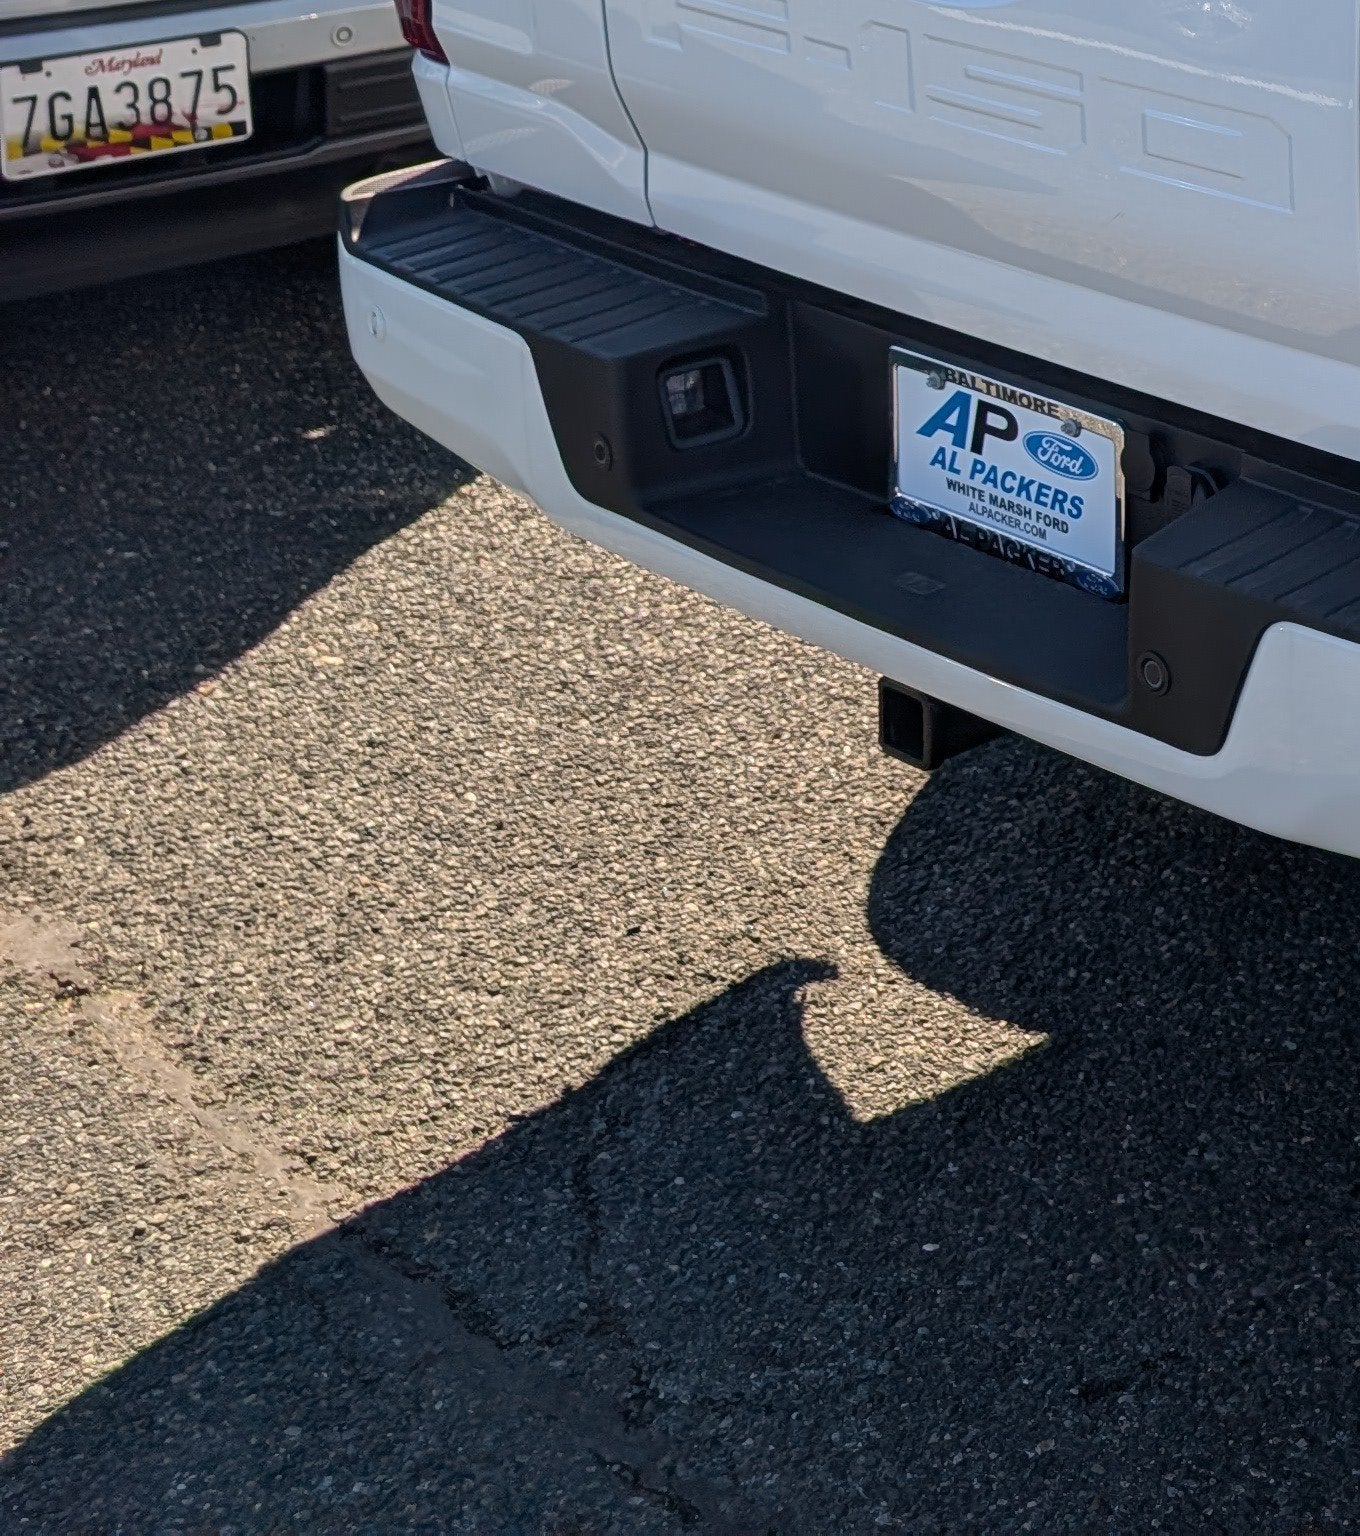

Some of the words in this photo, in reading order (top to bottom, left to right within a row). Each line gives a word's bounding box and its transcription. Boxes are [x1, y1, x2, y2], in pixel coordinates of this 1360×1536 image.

[84, 48, 164, 77] Maryland
[11, 64, 238, 156] 7GA3875
[944, 368, 1060, 415] BALTIMORE
[915, 390, 1019, 456] AP
[1037, 437, 1084, 475] Ford
[929, 446, 962, 475] AL
[969, 459, 1085, 520] PACKERS
[946, 476, 986, 502] WHITE
[988, 495, 1032, 521] MARSH
[1035, 512, 1070, 535] FORD
[968, 501, 1048, 541] ALPACKER.COM
